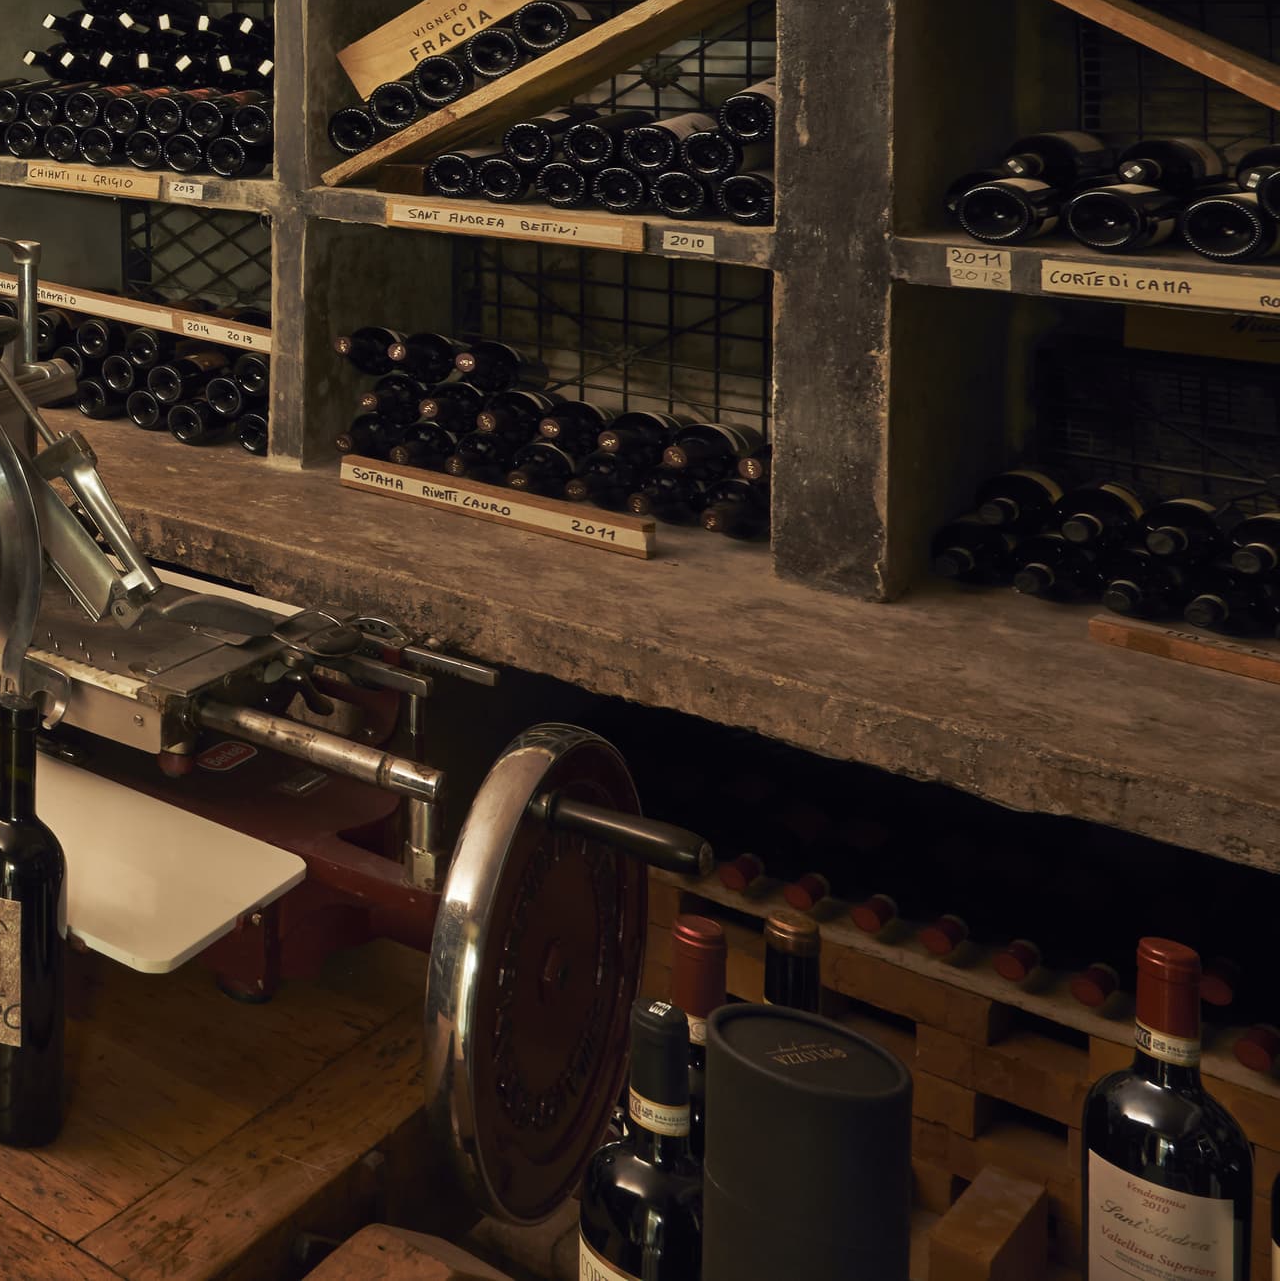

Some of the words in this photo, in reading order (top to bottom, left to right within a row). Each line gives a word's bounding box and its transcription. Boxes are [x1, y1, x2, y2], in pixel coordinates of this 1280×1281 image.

[412, 3, 468, 39] VIGNETO
[409, 10, 493, 62] FRACIA
[28, 167, 66, 183] CHIANTI
[94, 174, 134, 191] GRIGIO
[173, 183, 196, 194] 2013
[407, 208, 442, 221] SANT
[448, 212, 506, 229] ANDREA
[670, 235, 705, 249] 2010
[951, 248, 1002, 267] 2011
[952, 268, 1004, 285] 2012
[187, 321, 210, 335] 2014
[571, 519, 616, 541] 2011
[1126, 1180, 1186, 1210] Vendemmia
[1140, 1199, 1170, 1215] 2010
[1101, 1225, 1155, 1260] Valtellina
